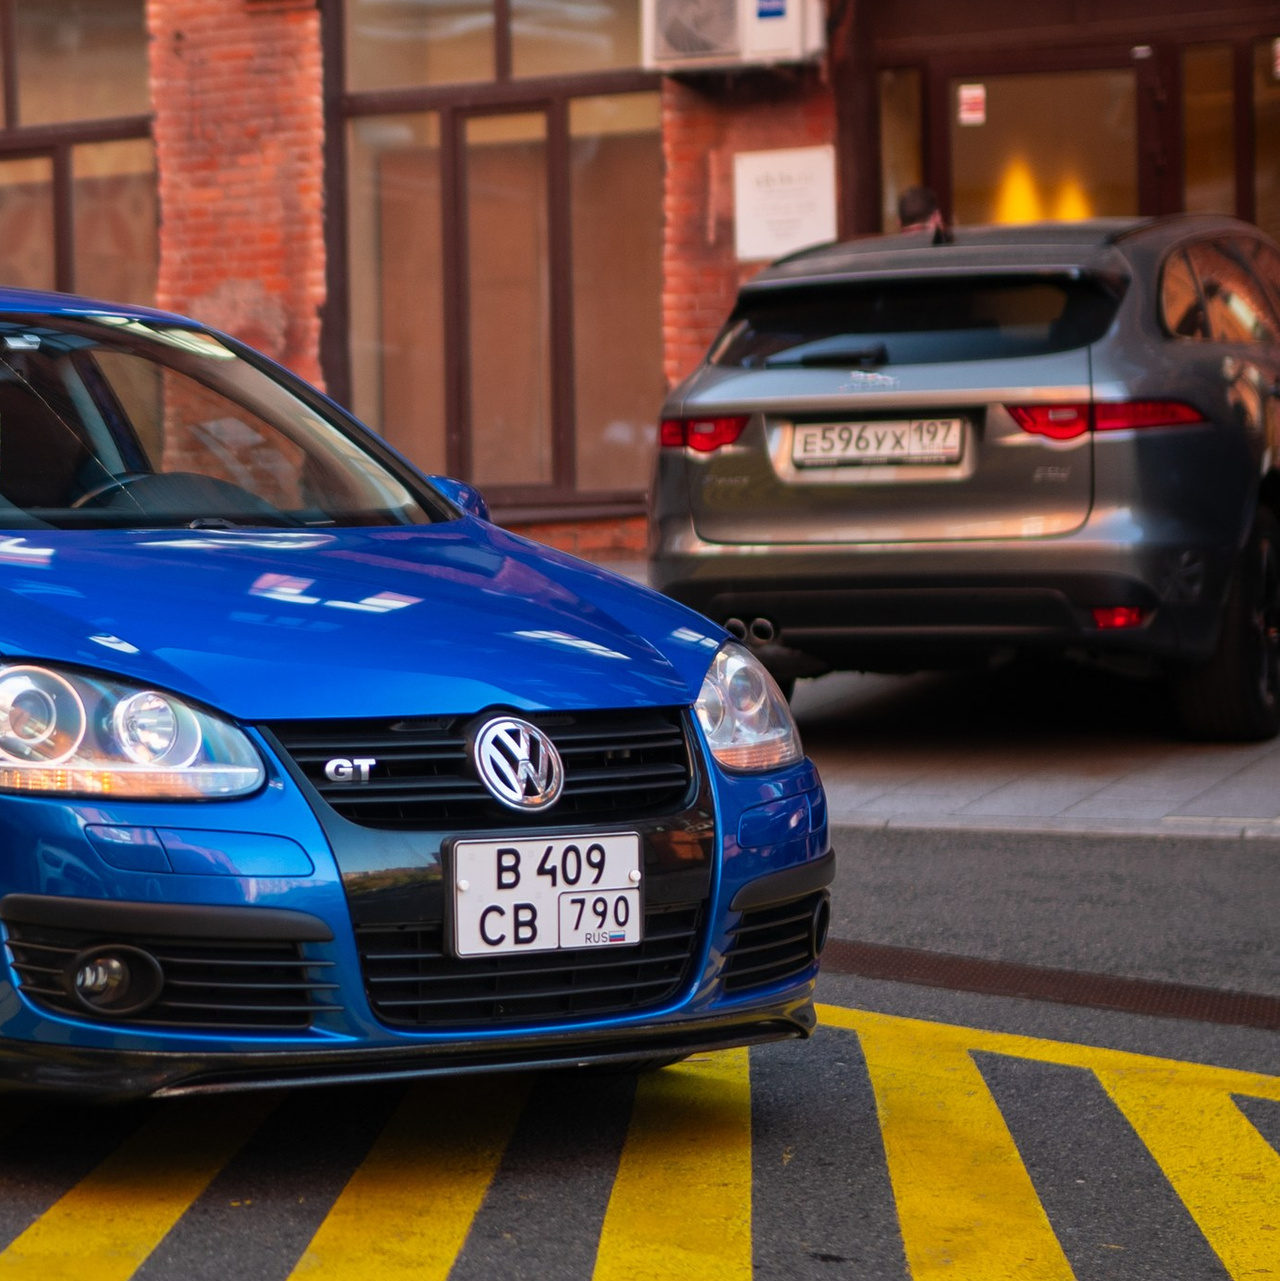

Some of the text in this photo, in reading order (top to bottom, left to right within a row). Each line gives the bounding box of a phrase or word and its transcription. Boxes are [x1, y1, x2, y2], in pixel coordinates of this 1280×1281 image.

[913, 420, 954, 443] 197
[324, 758, 376, 782] GT
[474, 716, 564, 811] VW
[496, 843, 606, 890] В 409
[479, 895, 630, 947] СВ 790
[585, 933, 608, 944] RUS
